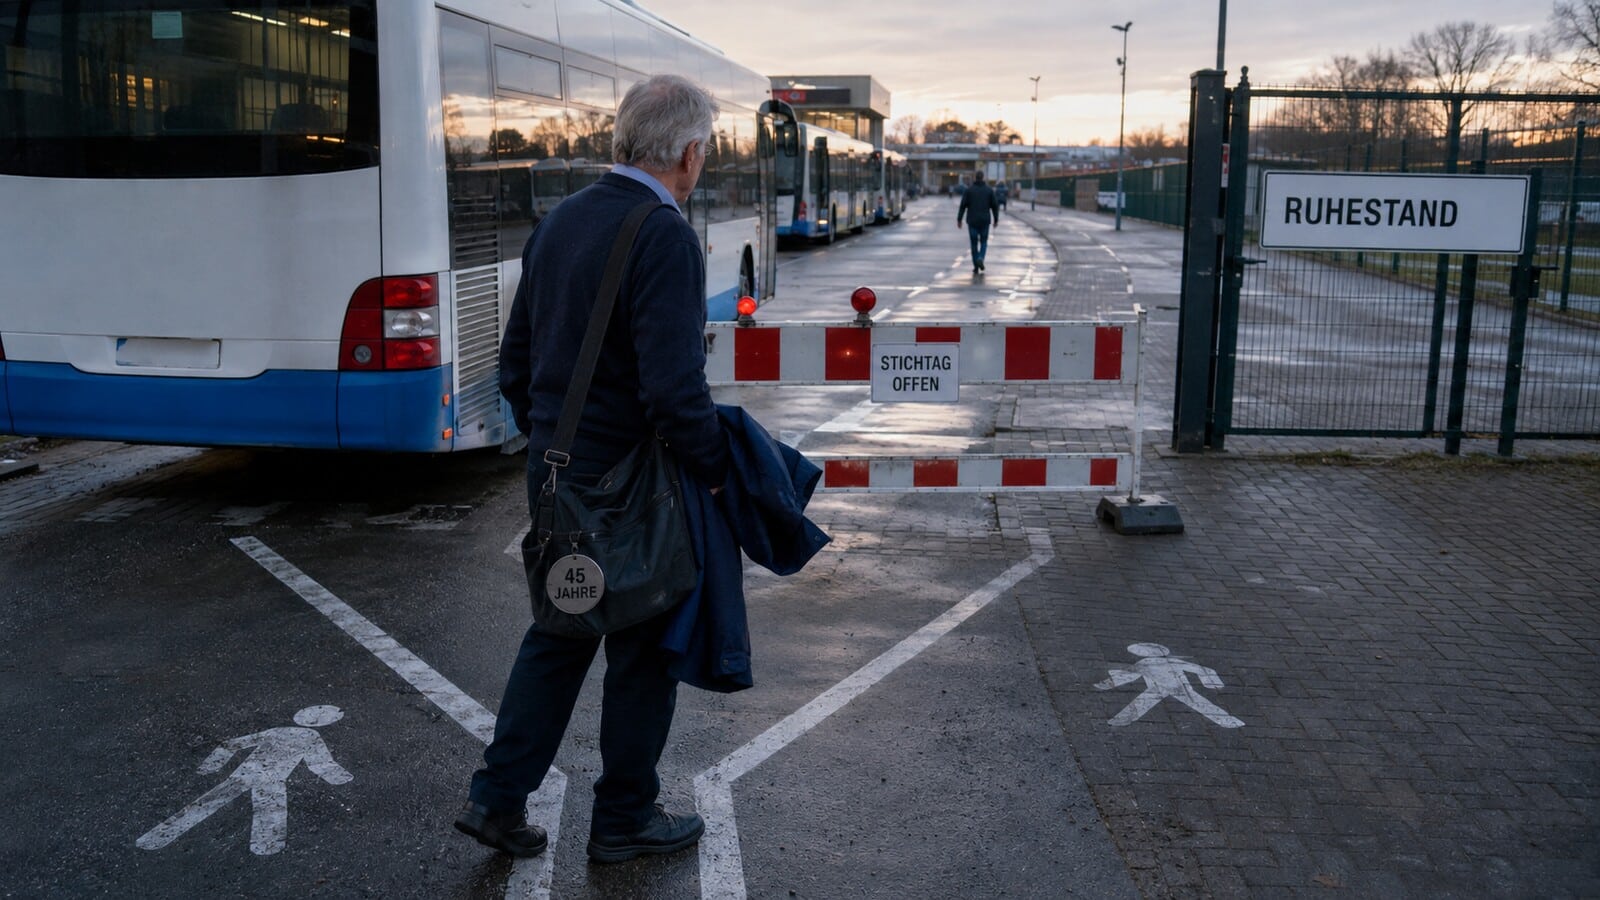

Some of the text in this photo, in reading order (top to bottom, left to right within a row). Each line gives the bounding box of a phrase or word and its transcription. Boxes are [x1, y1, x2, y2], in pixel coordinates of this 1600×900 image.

[1284, 196, 1458, 227] RUHESTAND
[880, 355, 951, 370] STICHTAG
[892, 376, 939, 391] OFFEN
[565, 567, 585, 584] 45
[554, 586, 597, 599] JAHRE
